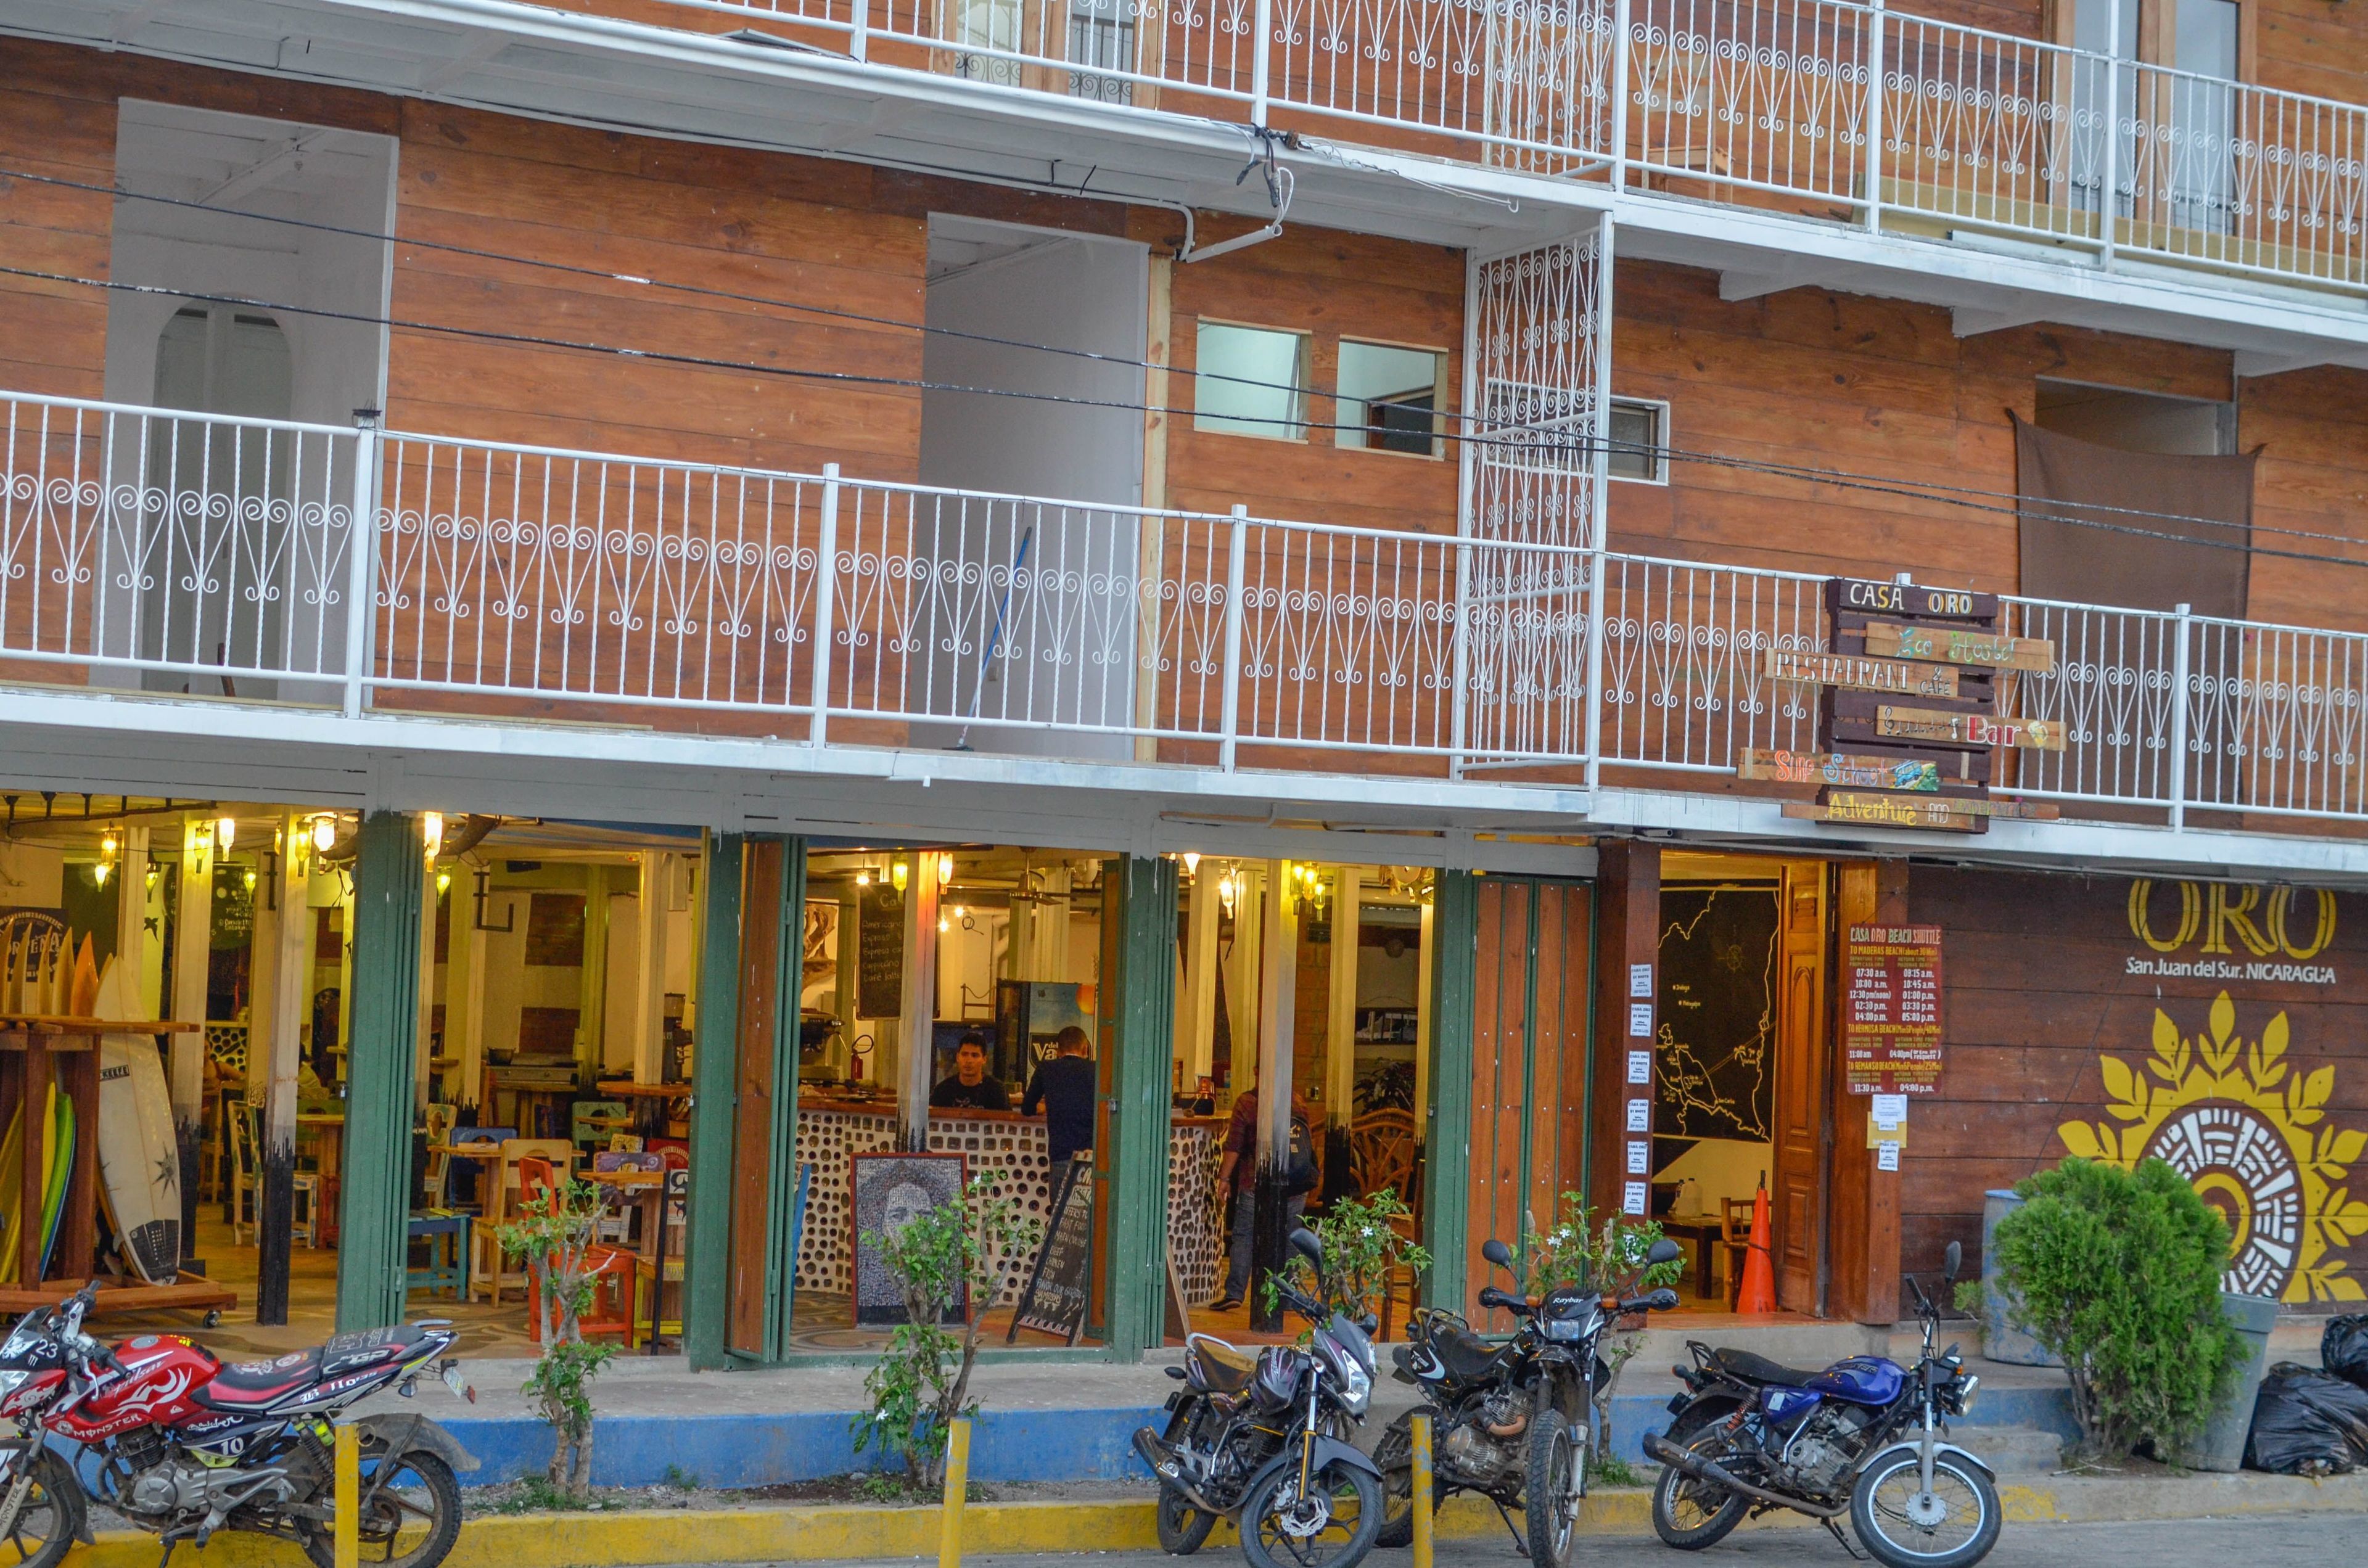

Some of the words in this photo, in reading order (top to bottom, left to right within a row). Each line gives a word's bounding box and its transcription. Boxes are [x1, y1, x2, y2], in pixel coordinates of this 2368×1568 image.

[1850, 583, 1904, 610] CASA
[1928, 593, 1972, 614] ORO
[1896, 626, 1932, 658] Eco
[1949, 630, 2016, 663] Hostel
[1775, 652, 1910, 690] RESTAURANT
[1932, 666, 1942, 681] &
[1967, 715, 2021, 747] Bar
[1828, 793, 1917, 826] Adventure
[1928, 803, 1949, 823] AND
[2128, 878, 2337, 959] ORO
[1850, 927, 1870, 942] CASA
[1871, 928, 1886, 943] ORO
[1888, 928, 1911, 943] BEACH
[1912, 929, 1941, 944] SHUTTLE
[1850, 945, 1857, 954] TO
[1858, 946, 1885, 955] MADERAS
[1856, 968, 1873, 977] 07:30
[2126, 957, 2153, 974] San
[2155, 958, 2192, 977] Juan
[2193, 961, 2215, 978] del
[2246, 963, 2337, 983] NICARAGUA
[1856, 979, 1872, 988] 10:00
[1904, 980, 1922, 988] 10:45
[1902, 991, 1921, 999] 01:00
[1922, 992, 1936, 1001] p.m.
[1855, 1001, 1873, 1010] 02:30
[1873, 1003, 1888, 1011] p.m.
[1902, 1001, 1920, 1010] 03:30
[1921, 1003, 1936, 1012] p.m.
[1855, 1012, 1873, 1021] 04:00
[1902, 1012, 1920, 1021] 05:00
[1921, 1014, 1936, 1023] p.m.
[1848, 1024, 1855, 1033] TO
[1856, 1024, 1878, 1033] HERMOSA
[1855, 1083, 1870, 1093] 11:30
[1919, 1085, 1934, 1093] p.m.
[1552, 1297, 1584, 1305] Raybar
[35, 1338, 58, 1359] 23
[112, 1360, 165, 1398] Pulsar
[73, 1413, 142, 1438] MONSTER
[221, 1437, 245, 1455] 10
